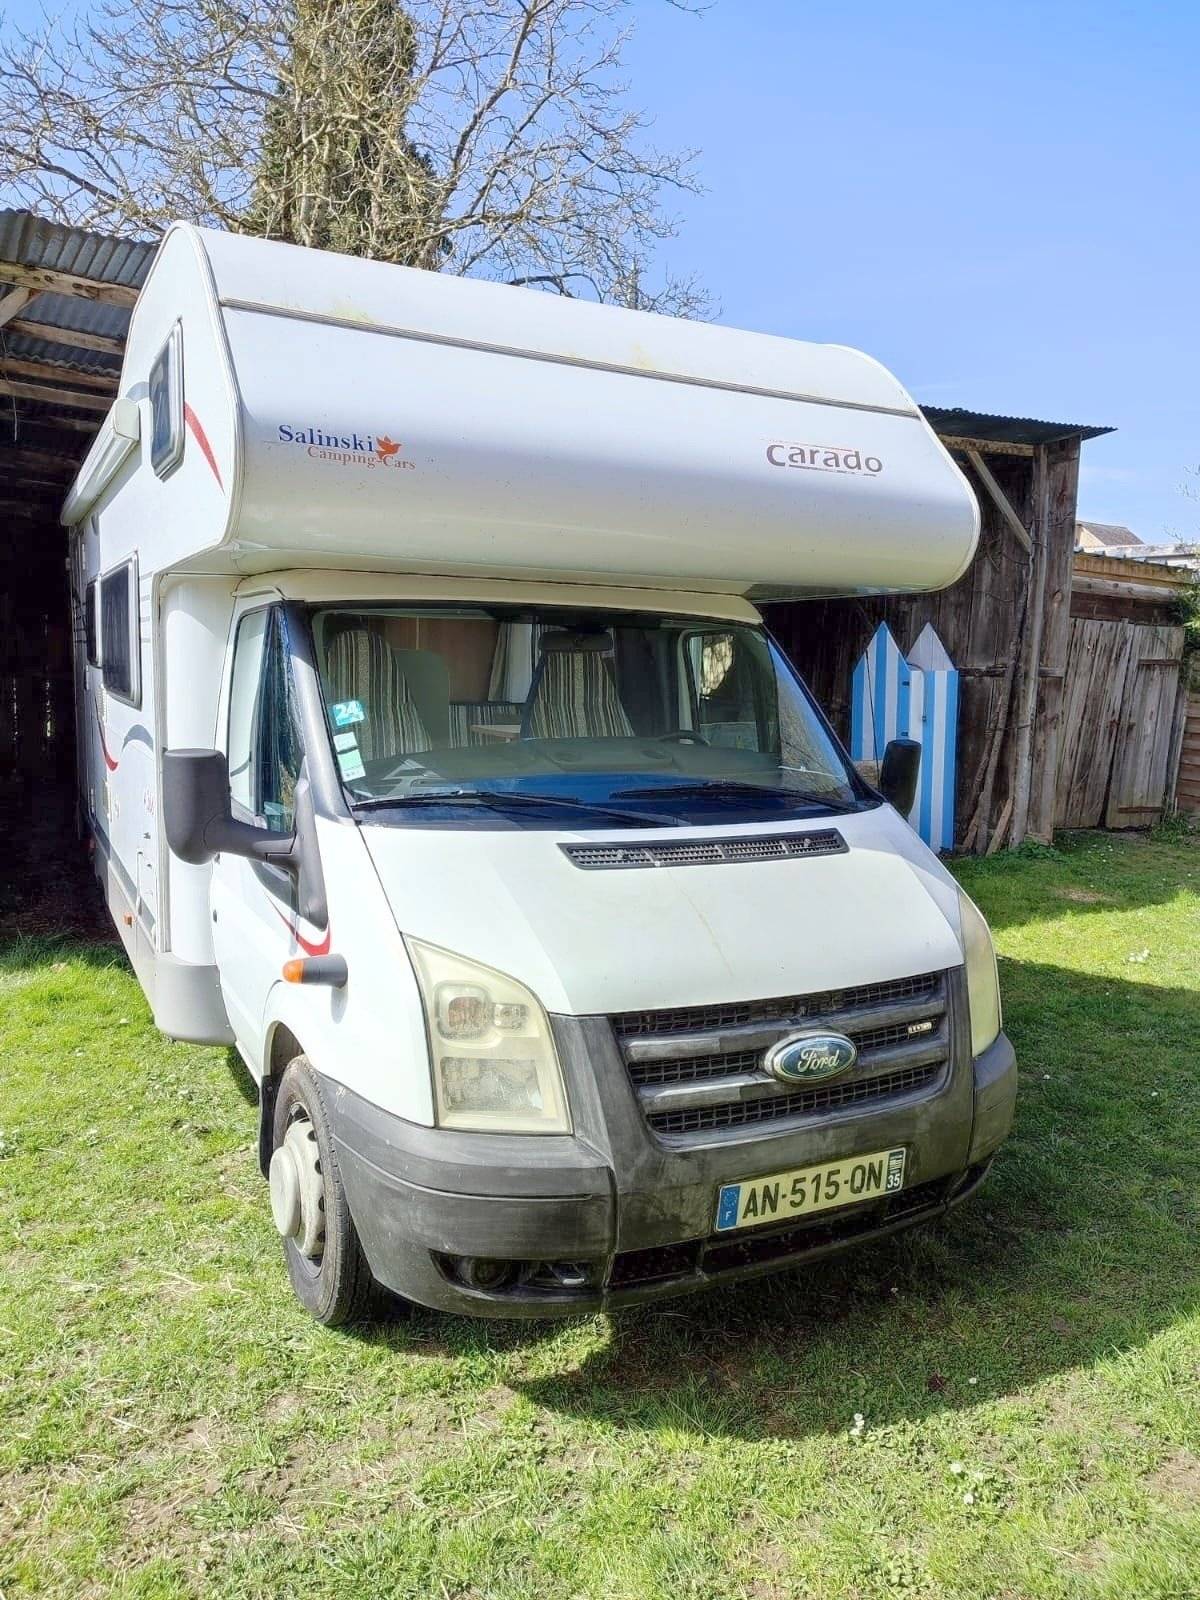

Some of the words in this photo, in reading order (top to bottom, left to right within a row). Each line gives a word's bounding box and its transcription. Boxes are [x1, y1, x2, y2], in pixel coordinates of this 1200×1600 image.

[278, 424, 374, 452] Salinski
[307, 446, 416, 470] Camping-Cars
[766, 444, 883, 473] Carado
[797, 1046, 841, 1073] Ford
[742, 1159, 884, 1219] AN-515-QN
[887, 1173, 901, 1189] 35
